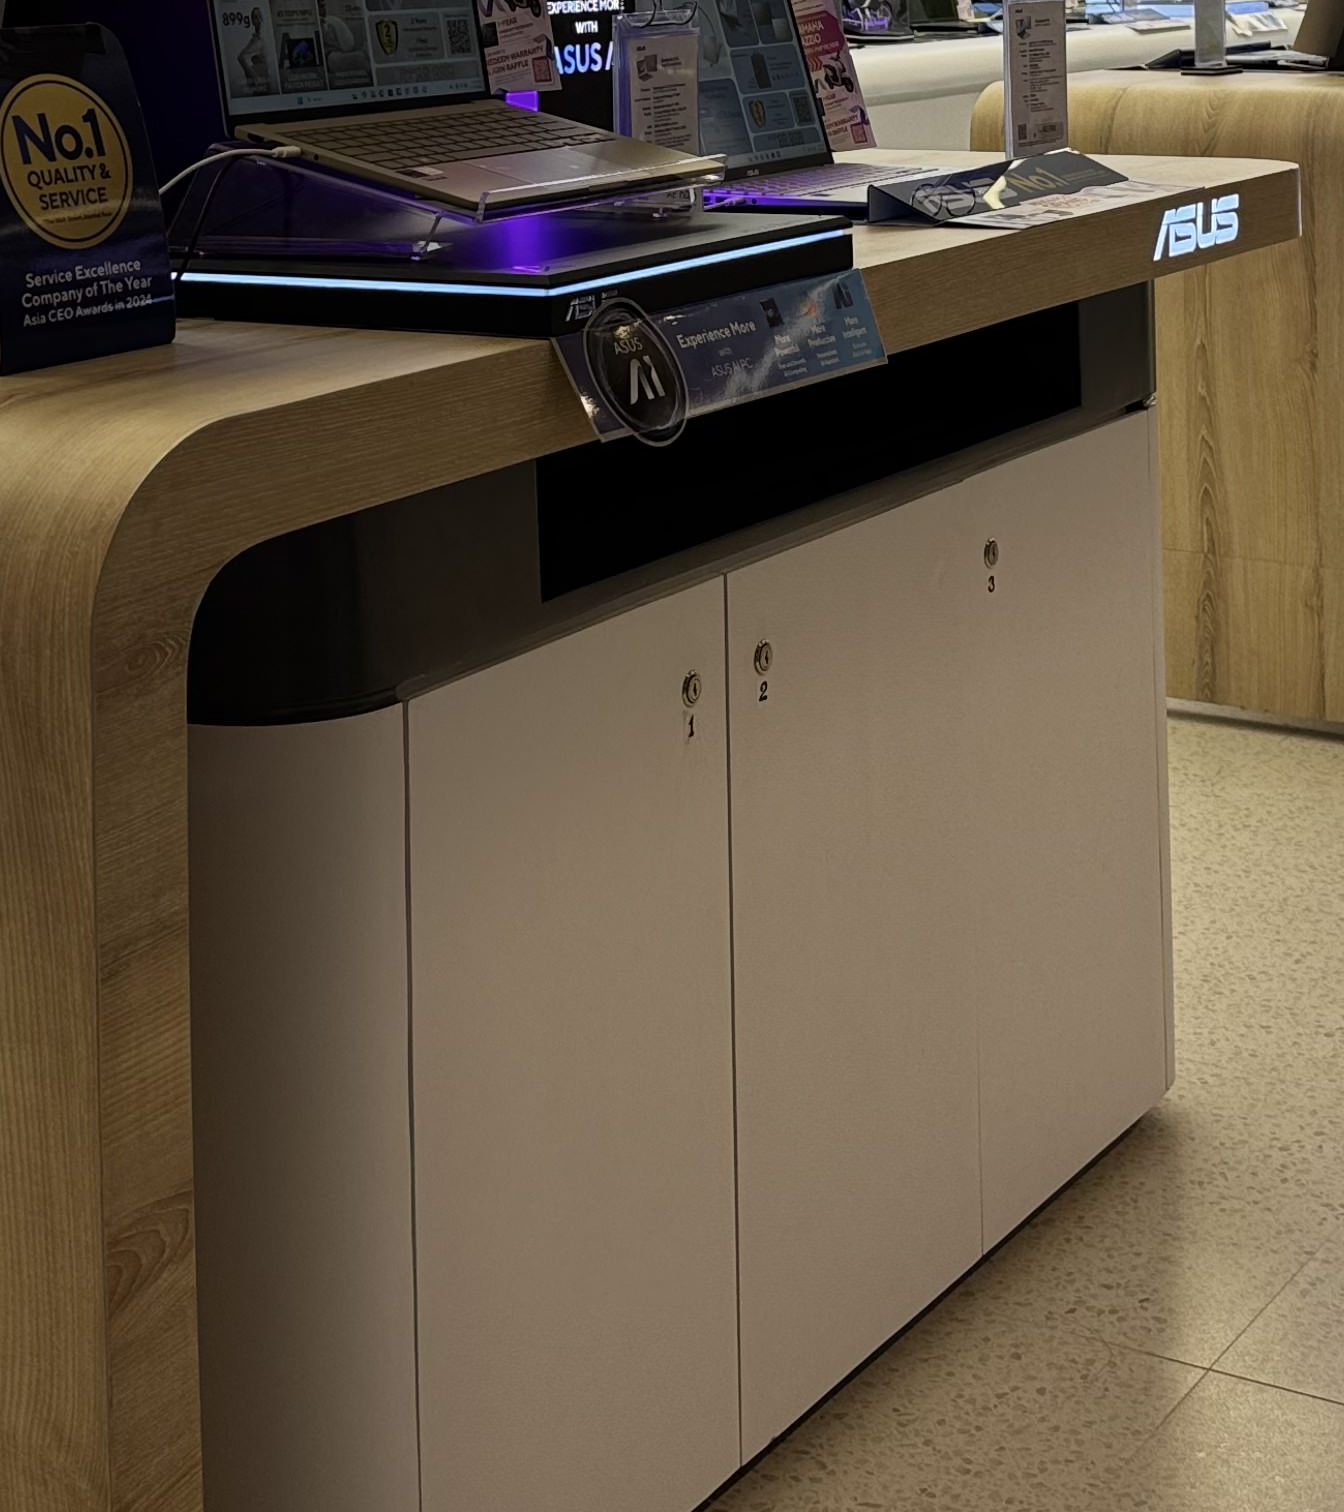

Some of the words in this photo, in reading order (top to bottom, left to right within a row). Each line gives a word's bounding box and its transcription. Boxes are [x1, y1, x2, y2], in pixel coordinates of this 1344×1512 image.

[547, 0, 598, 15] EXPERIENCE
[222, 12, 250, 28] 899g
[575, 21, 598, 34] WITH
[11, 107, 107, 166] No.1
[27, 165, 97, 189] QUALITY
[98, 166, 112, 180] &
[39, 186, 108, 211] SERVICE
[1152, 193, 1240, 262] ASUS
[25, 269, 73, 289] Service
[74, 259, 141, 281] Excellence
[21, 284, 83, 309] Company
[85, 281, 98, 297] of
[99, 279, 124, 295] The
[126, 275, 152, 291] Year
[24, 310, 46, 327] Asia
[48, 306, 74, 323] CEO
[75, 300, 114, 318] Awards
[115, 300, 125, 311] in
[126, 293, 153, 308] 2024
[613, 337, 643, 355] ASUS
[676, 329, 731, 349] Experience
[729, 321, 756, 336] More
[987, 575, 996, 593] 3
[758, 680, 769, 702] 2
[687, 714, 696, 738] 1
